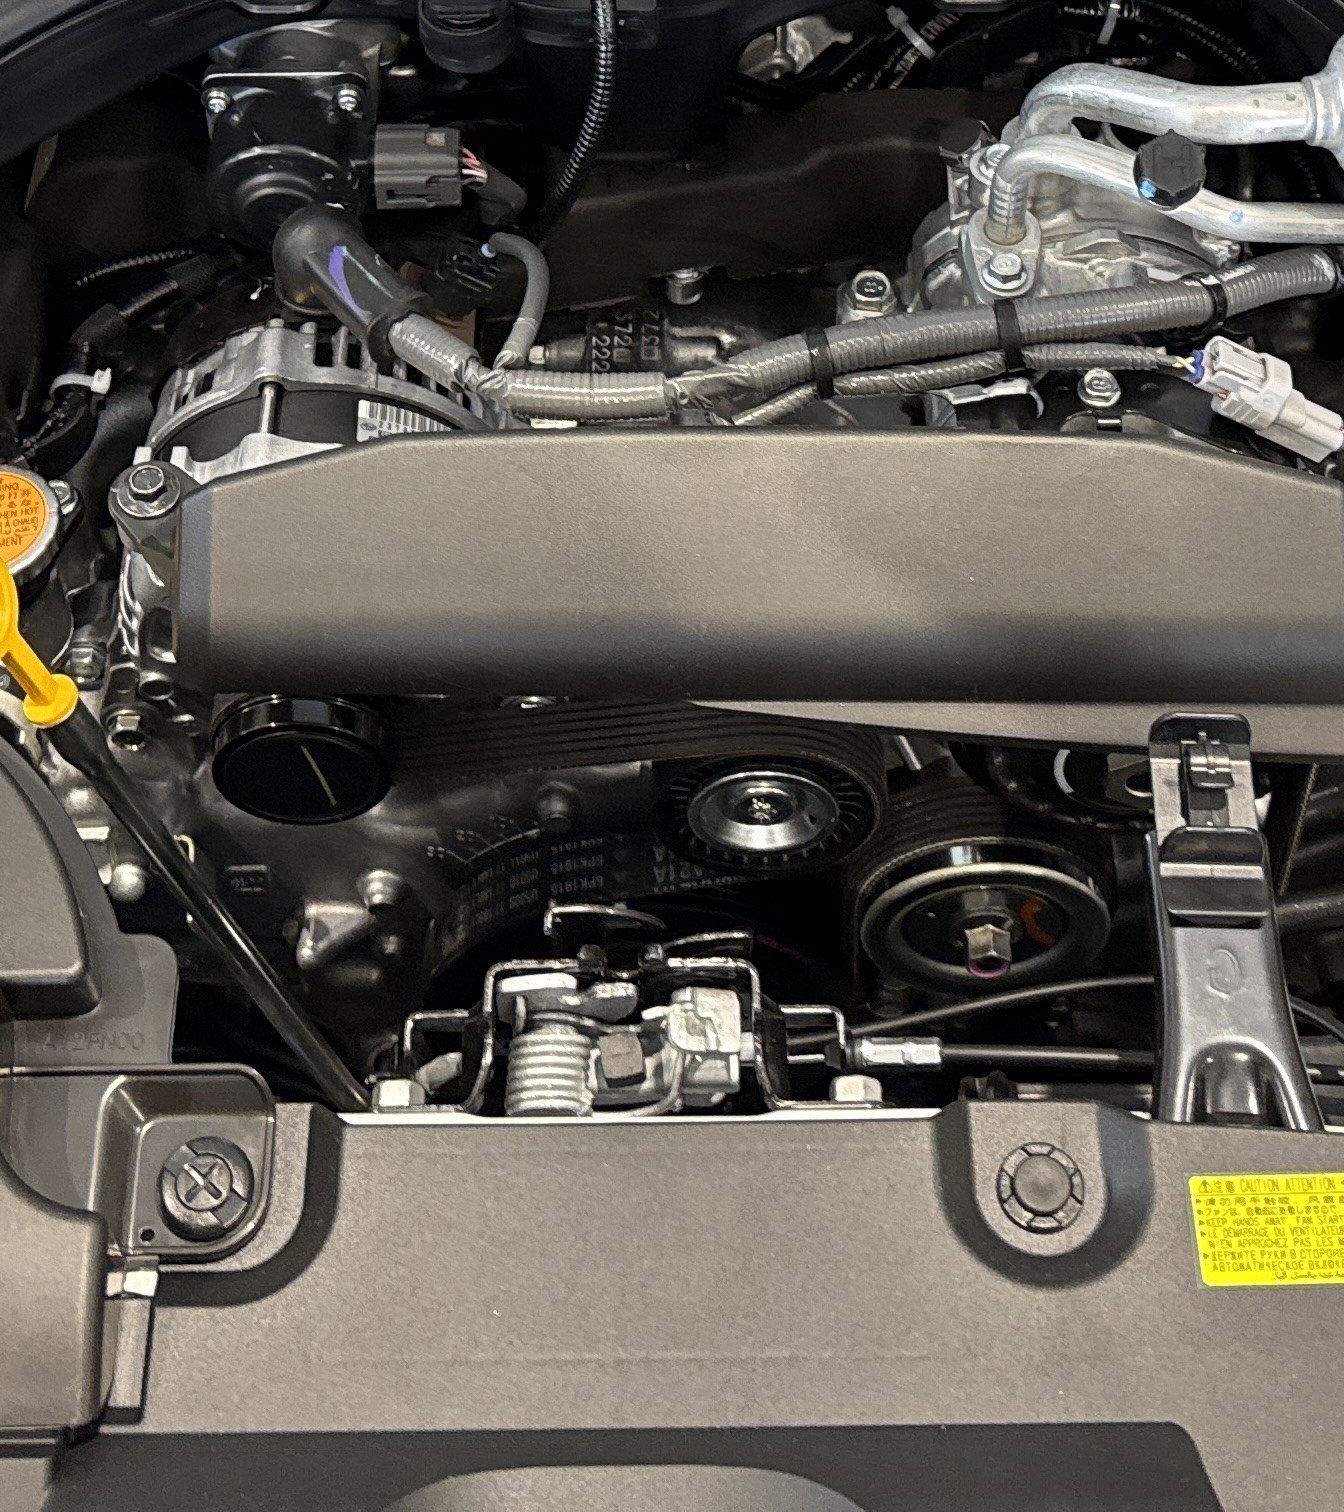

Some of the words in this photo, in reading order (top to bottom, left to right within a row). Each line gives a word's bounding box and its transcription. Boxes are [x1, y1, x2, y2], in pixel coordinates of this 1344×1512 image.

[1239, 1178, 1280, 1192] CAUTION
[1285, 1177, 1336, 1192] ATTENTION
[1206, 1217, 1228, 1227] KEEP
[1232, 1217, 1260, 1226] HANDS
[1296, 1216, 1314, 1225] FAN
[1208, 1229, 1217, 1238] LE
[1274, 1228, 1286, 1237] DU
[1237, 1238, 1288, 1249] APPROCHEZ
[1293, 1237, 1312, 1247] PAS
[1316, 1237, 1333, 1247] LES
